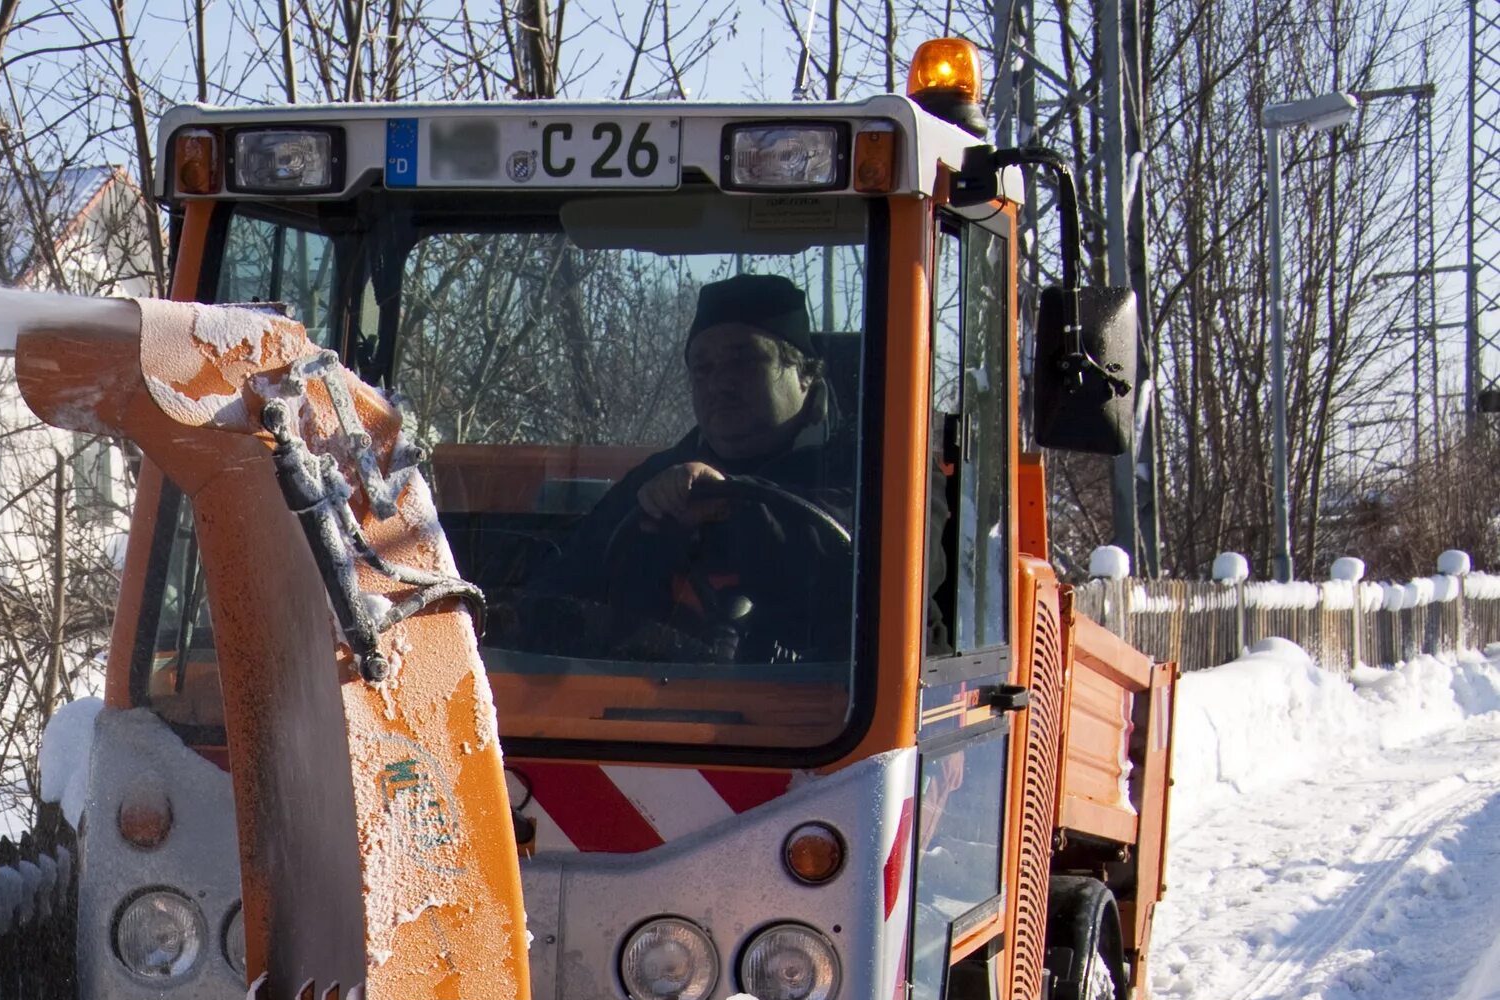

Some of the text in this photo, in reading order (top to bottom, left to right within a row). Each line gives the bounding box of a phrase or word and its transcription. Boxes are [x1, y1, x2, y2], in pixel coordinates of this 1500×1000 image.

[396, 158, 408, 173] D
[542, 122, 575, 178] C
[591, 121, 659, 178] 26
